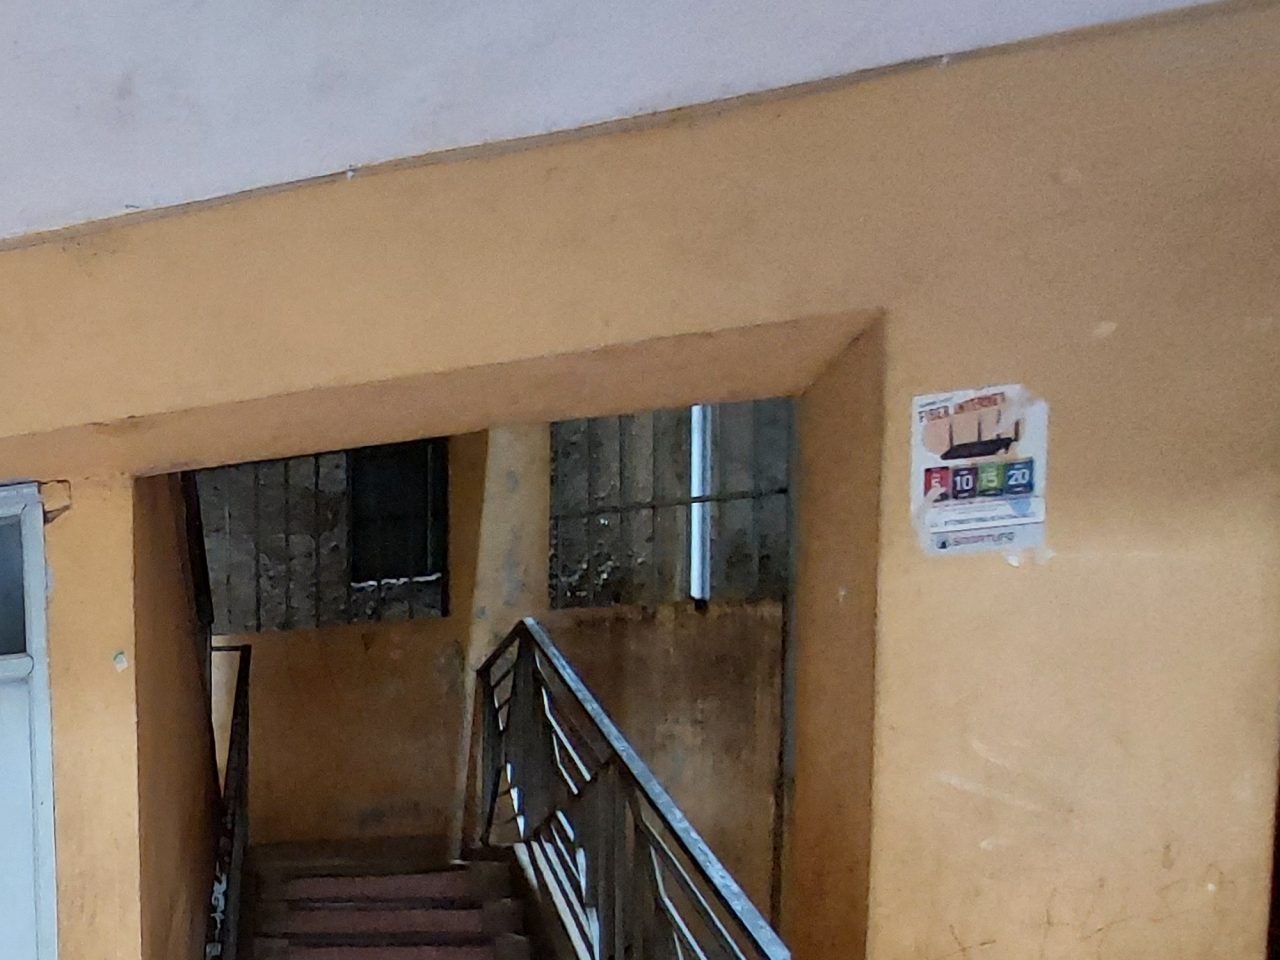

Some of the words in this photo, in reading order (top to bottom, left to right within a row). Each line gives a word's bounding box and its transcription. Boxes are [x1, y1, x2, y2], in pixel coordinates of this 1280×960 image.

[954, 474, 973, 491] 10
[980, 471, 998, 487] 15
[1007, 468, 1028, 485] 20
